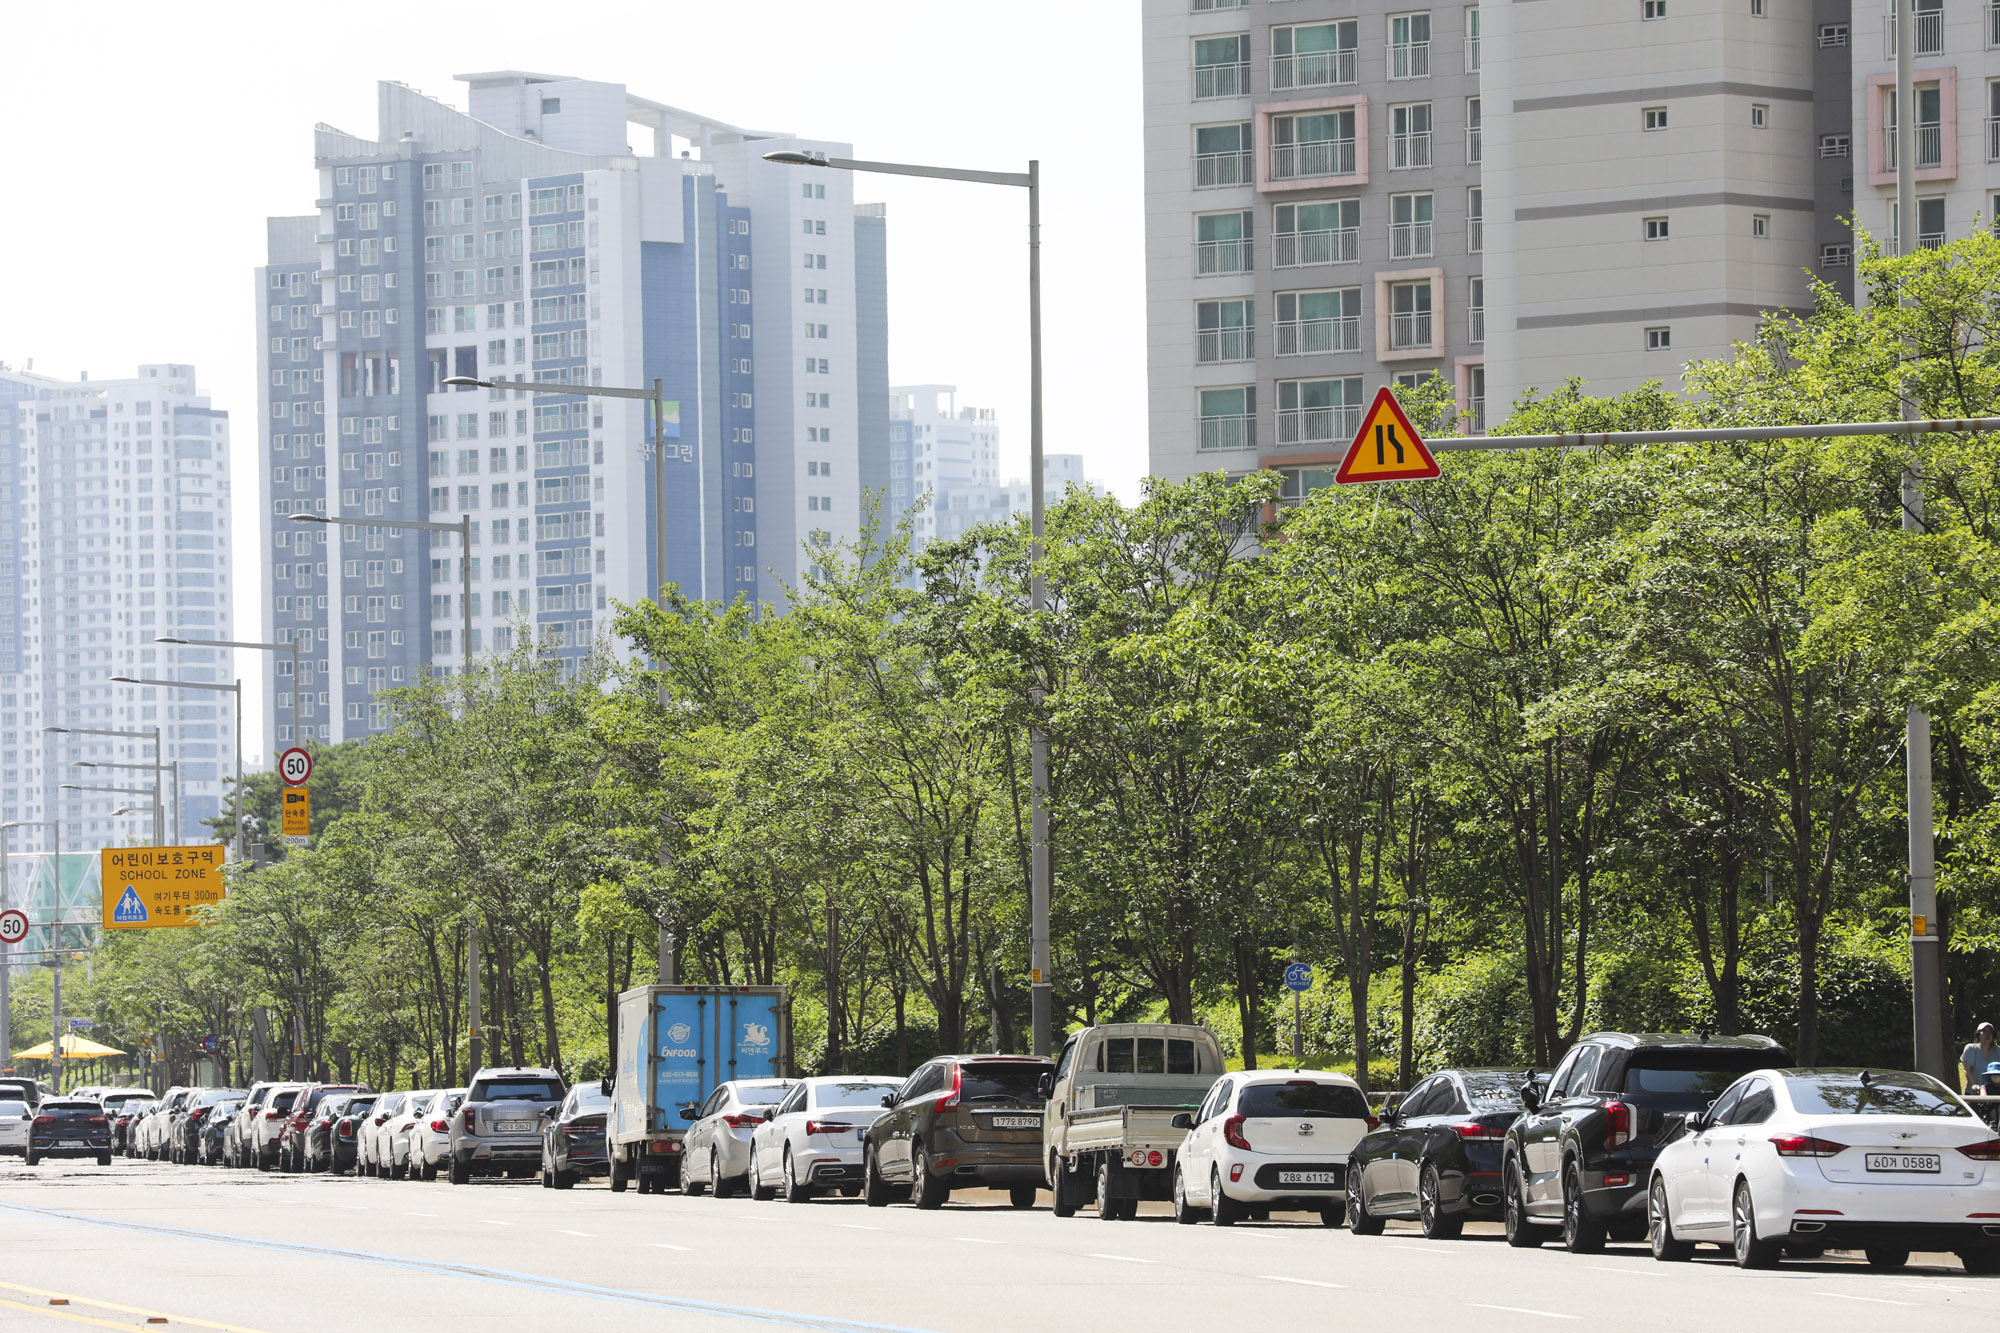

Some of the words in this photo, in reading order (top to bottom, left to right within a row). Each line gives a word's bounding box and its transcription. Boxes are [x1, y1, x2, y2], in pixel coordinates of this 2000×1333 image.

[287, 758, 305, 775] 50
[286, 837, 306, 845] 200m
[112, 850, 213, 867] 어린이보호구역
[120, 869, 168, 881] SCHOOL
[175, 868, 207, 880] ZONE
[154, 891, 191, 901] 여기부터
[194, 890, 218, 901] 300m
[154, 904, 181, 916] 속도를
[3, 919, 21, 935] 50
[996, 1118, 1017, 1126] 177오
[1018, 1118, 1038, 1126] 8790
[1873, 1156, 1897, 1168] 60거
[1902, 1157, 1933, 1169] 0588
[1283, 1172, 1301, 1182] 28오
[1305, 1173, 1329, 1182] 6112
